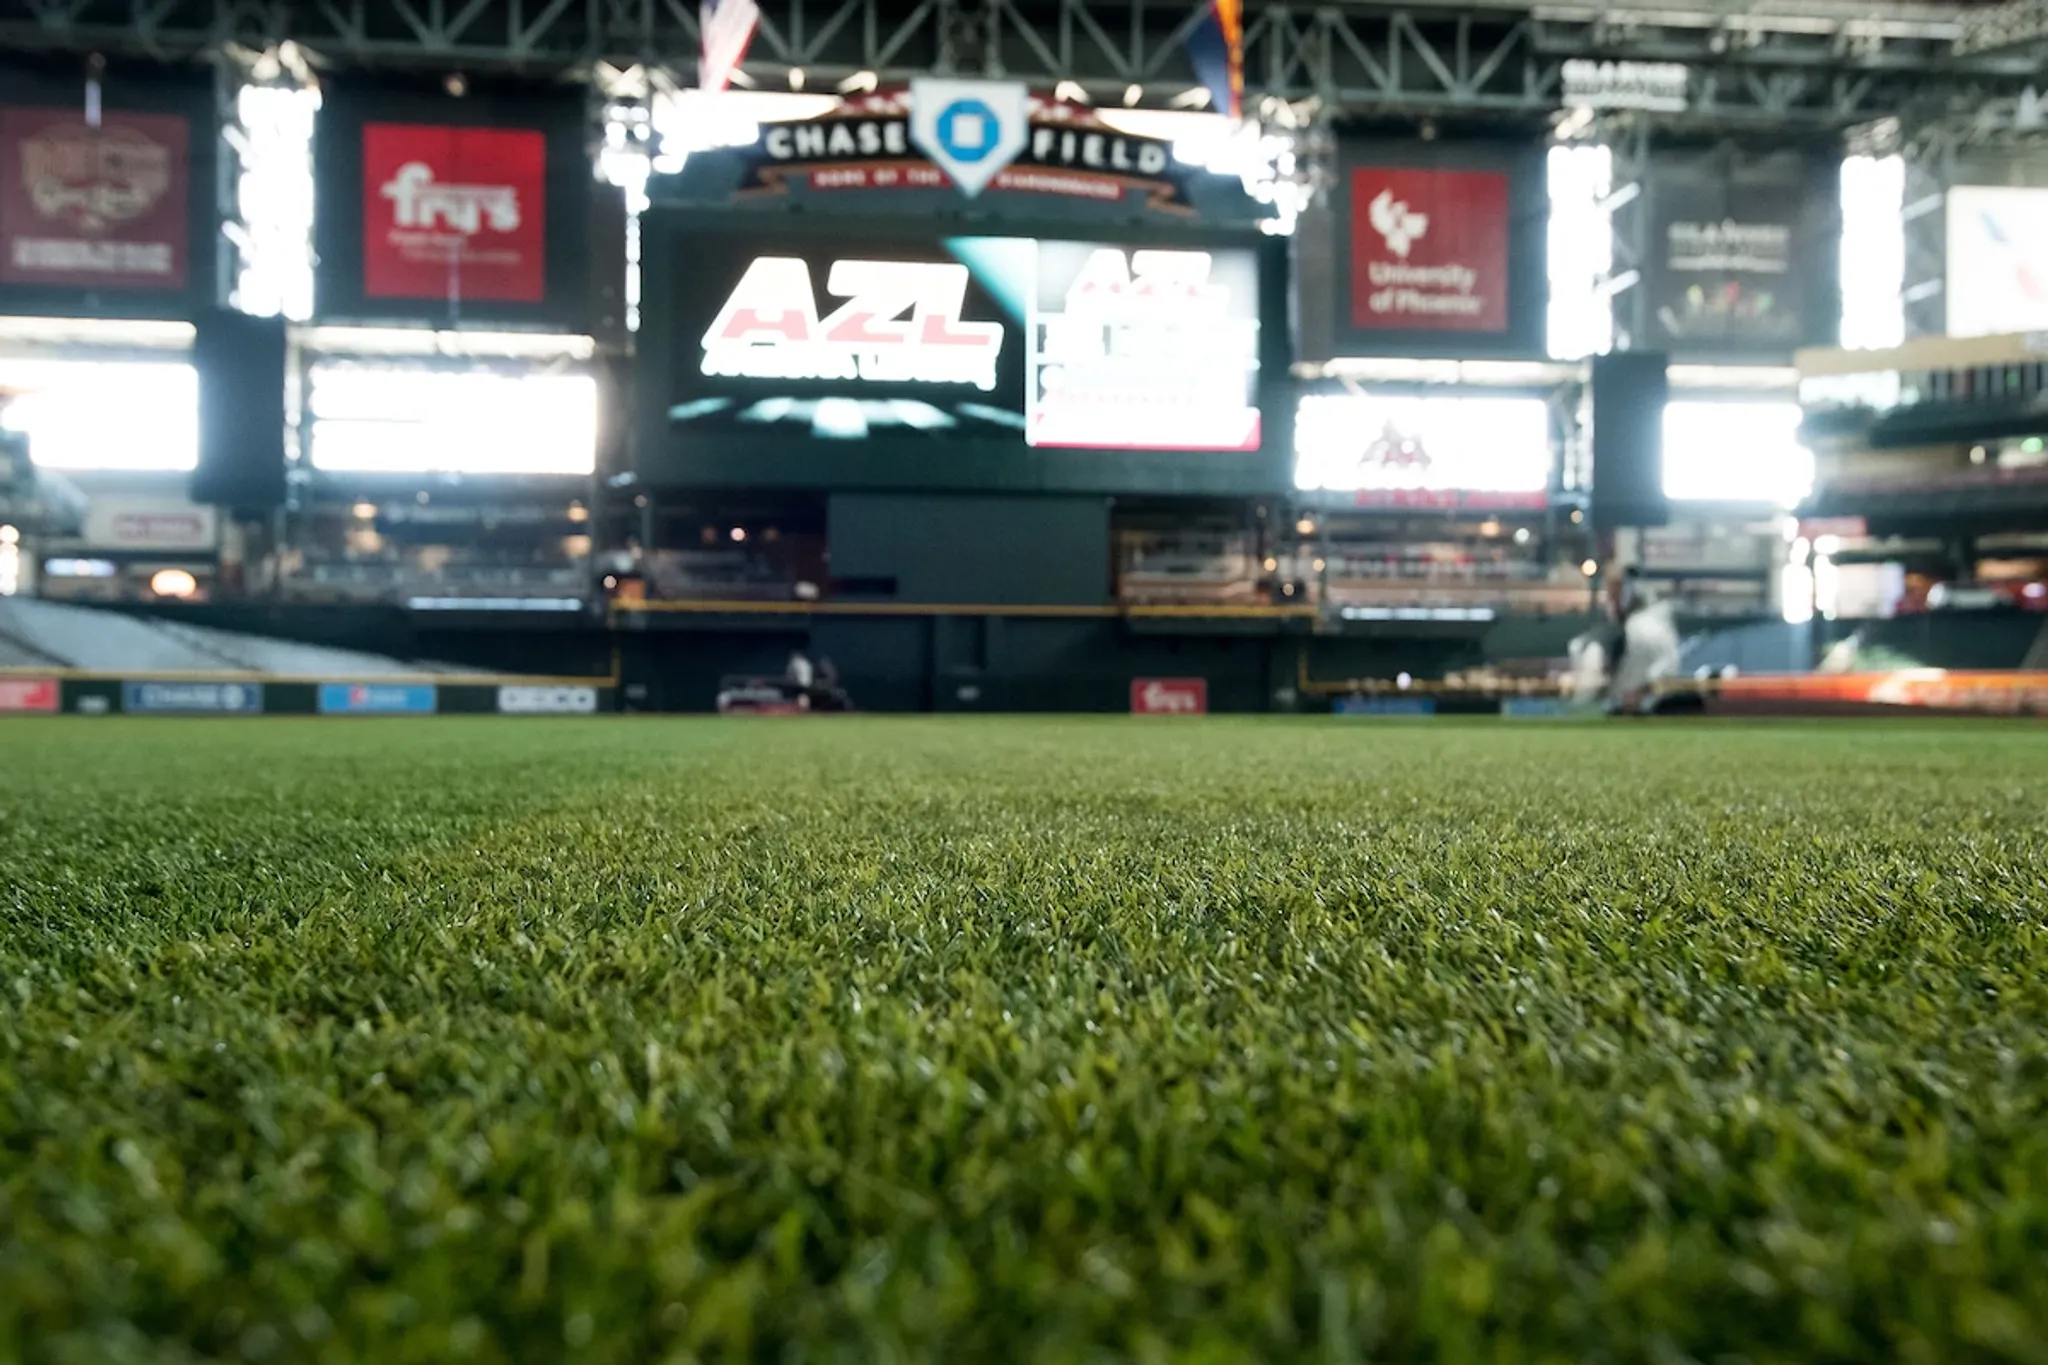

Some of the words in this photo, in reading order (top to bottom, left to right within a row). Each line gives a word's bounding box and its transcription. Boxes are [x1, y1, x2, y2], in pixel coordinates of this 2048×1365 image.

[766, 122, 906, 159] CHASE
[1033, 127, 1167, 175] FIELD
[1368, 260, 1478, 297] University
[701, 256, 1004, 351] AZL
[1368, 285, 1394, 315] of
[499, 684, 596, 713] GEICO
